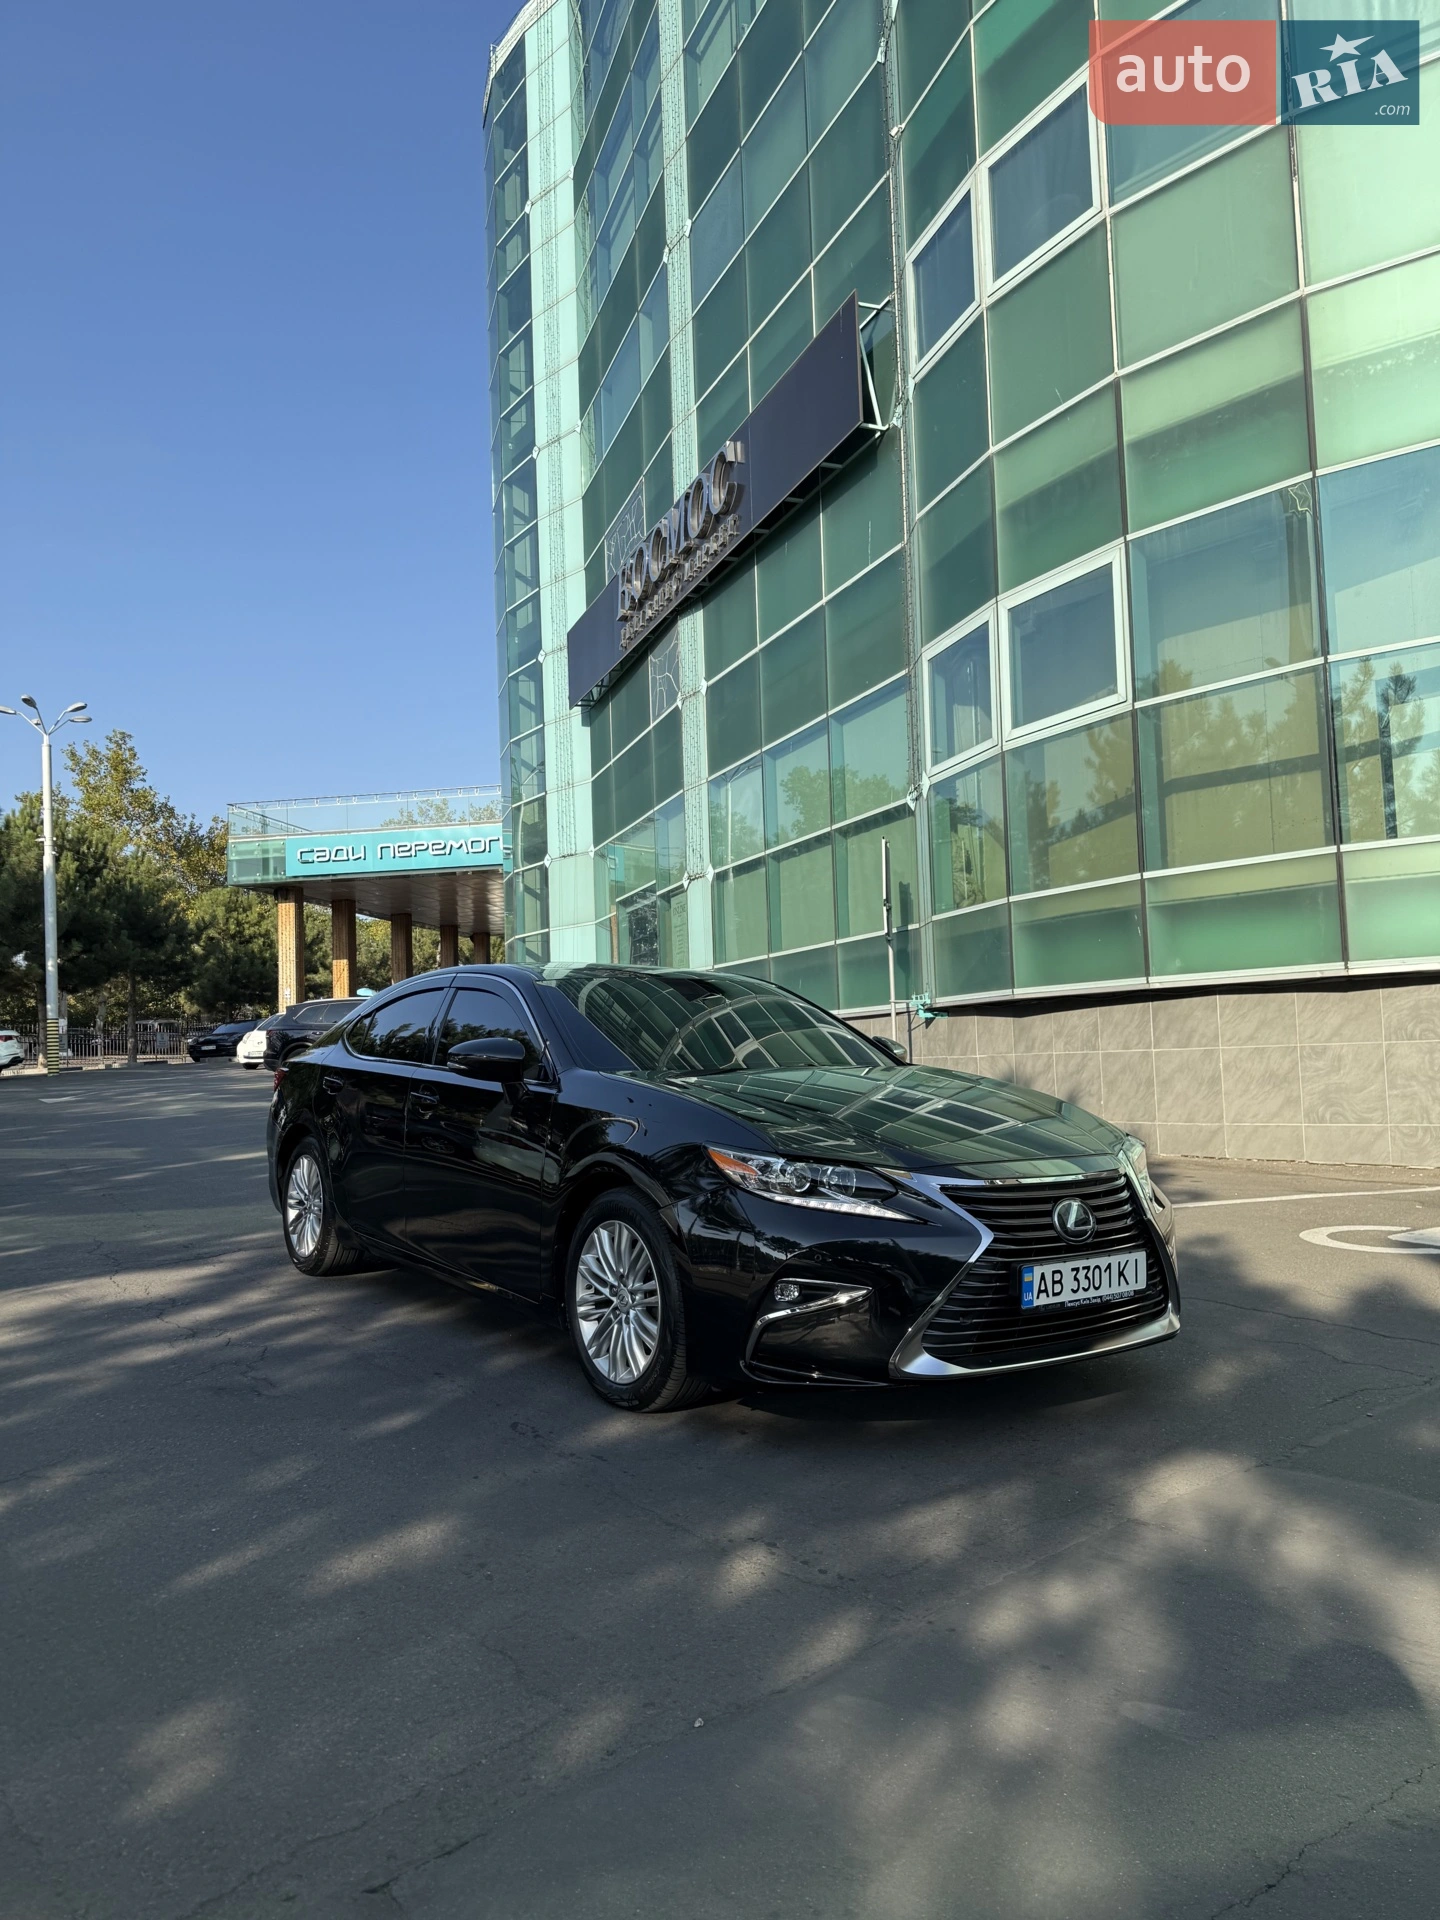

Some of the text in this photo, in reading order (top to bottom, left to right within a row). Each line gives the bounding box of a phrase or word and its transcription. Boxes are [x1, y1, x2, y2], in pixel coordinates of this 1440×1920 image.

[377, 835, 503, 859] перемог
[1036, 1258, 1138, 1300] AB 3301 KI
[1023, 1291, 1033, 1301] UA
